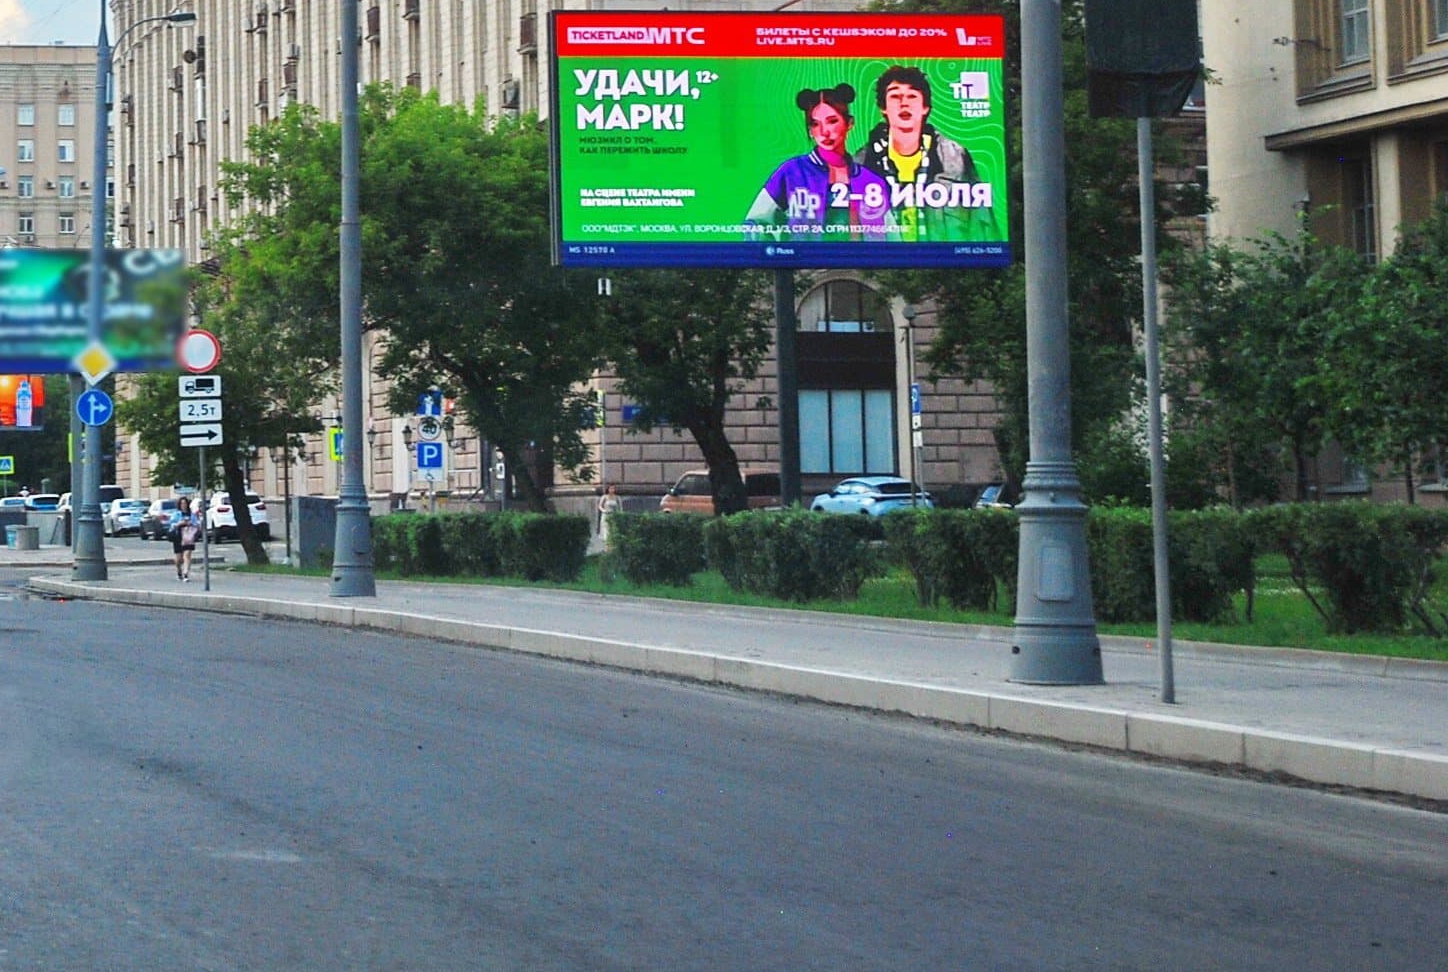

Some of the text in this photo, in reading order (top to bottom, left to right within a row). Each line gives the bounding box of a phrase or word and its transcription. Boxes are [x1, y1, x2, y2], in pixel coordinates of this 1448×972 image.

[571, 30, 645, 41] TICKETLAND
[755, 27, 948, 38] БИЛЕТЫ С КЕШБЭКОМ ДО 20%
[755, 36, 835, 46] LIVE.MTS.RU
[573, 69, 720, 101] УДАЧИ, 12+
[576, 103, 685, 130] МАРК!
[579, 136, 623, 144] МЮЗИКЛ
[623, 136, 633, 144] О
[579, 146, 598, 155] КАК
[599, 146, 651, 155] ПЕРЕЖИТЬ
[579, 188, 594, 197] НА
[626, 188, 661, 197] ТЕАТРА
[662, 188, 696, 197] ИМЕНИ
[890, 182, 994, 208] ИЮЛЯ
[580, 198, 685, 207] ЕВГЕНИЯ ВАХТАНГОВА
[825, 224, 850, 233] ОГРН
[423, 445, 438, 466] P
